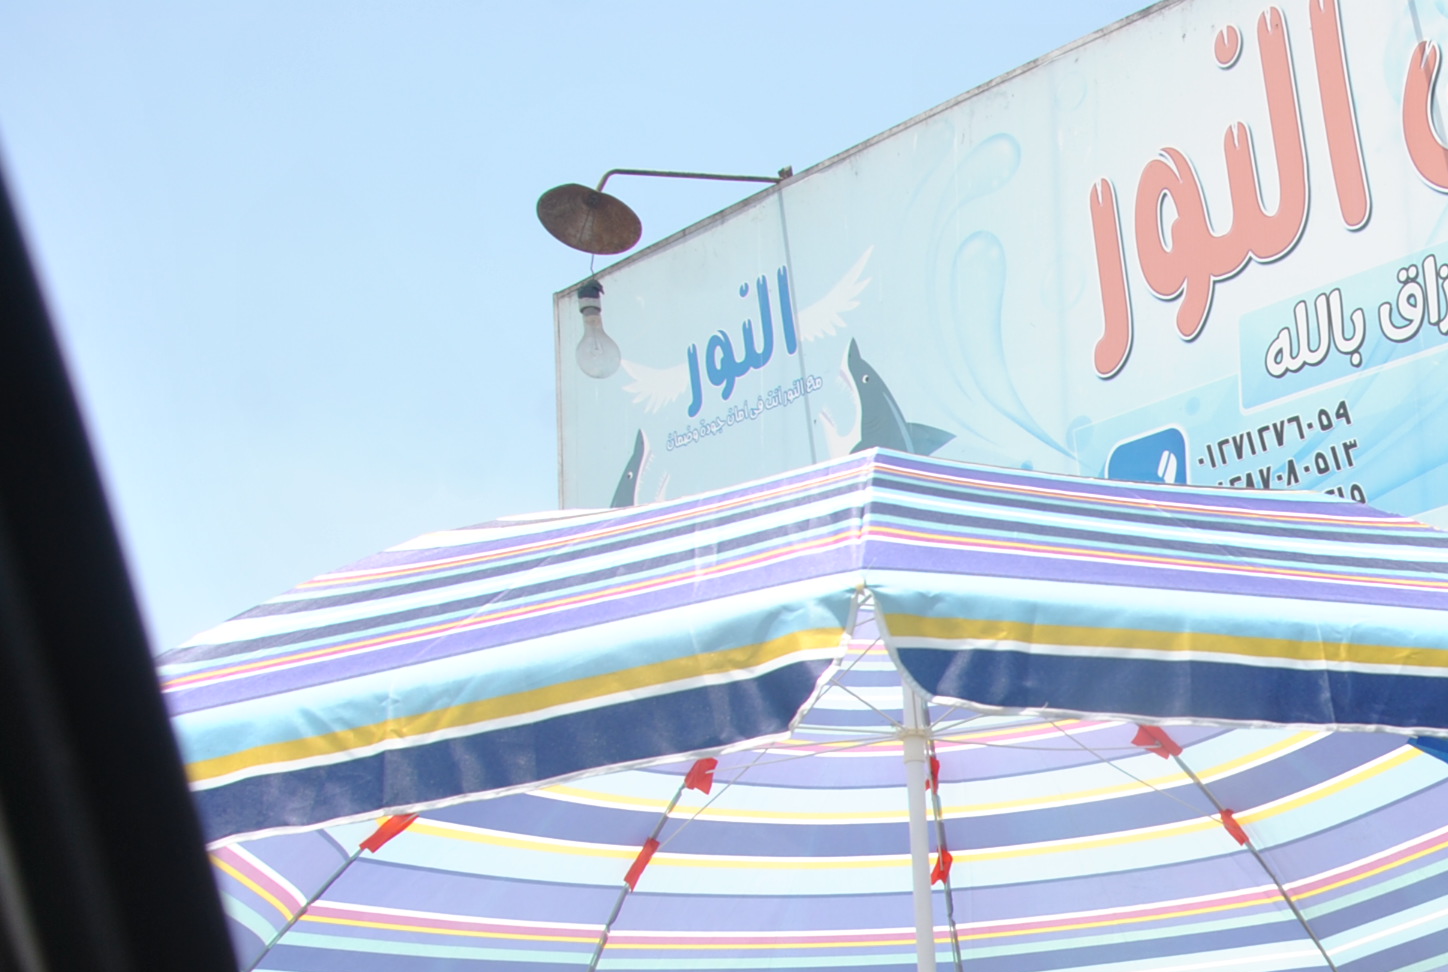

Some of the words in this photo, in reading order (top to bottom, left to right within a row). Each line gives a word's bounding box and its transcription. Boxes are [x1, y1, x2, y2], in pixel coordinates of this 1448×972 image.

[1088, 0, 1372, 380] النور
[687, 264, 798, 418] النور
[1265, 288, 1367, 378] بالله
[1197, 399, 1352, 469] ٠١٢٧١٢٧٦٠٥٩
